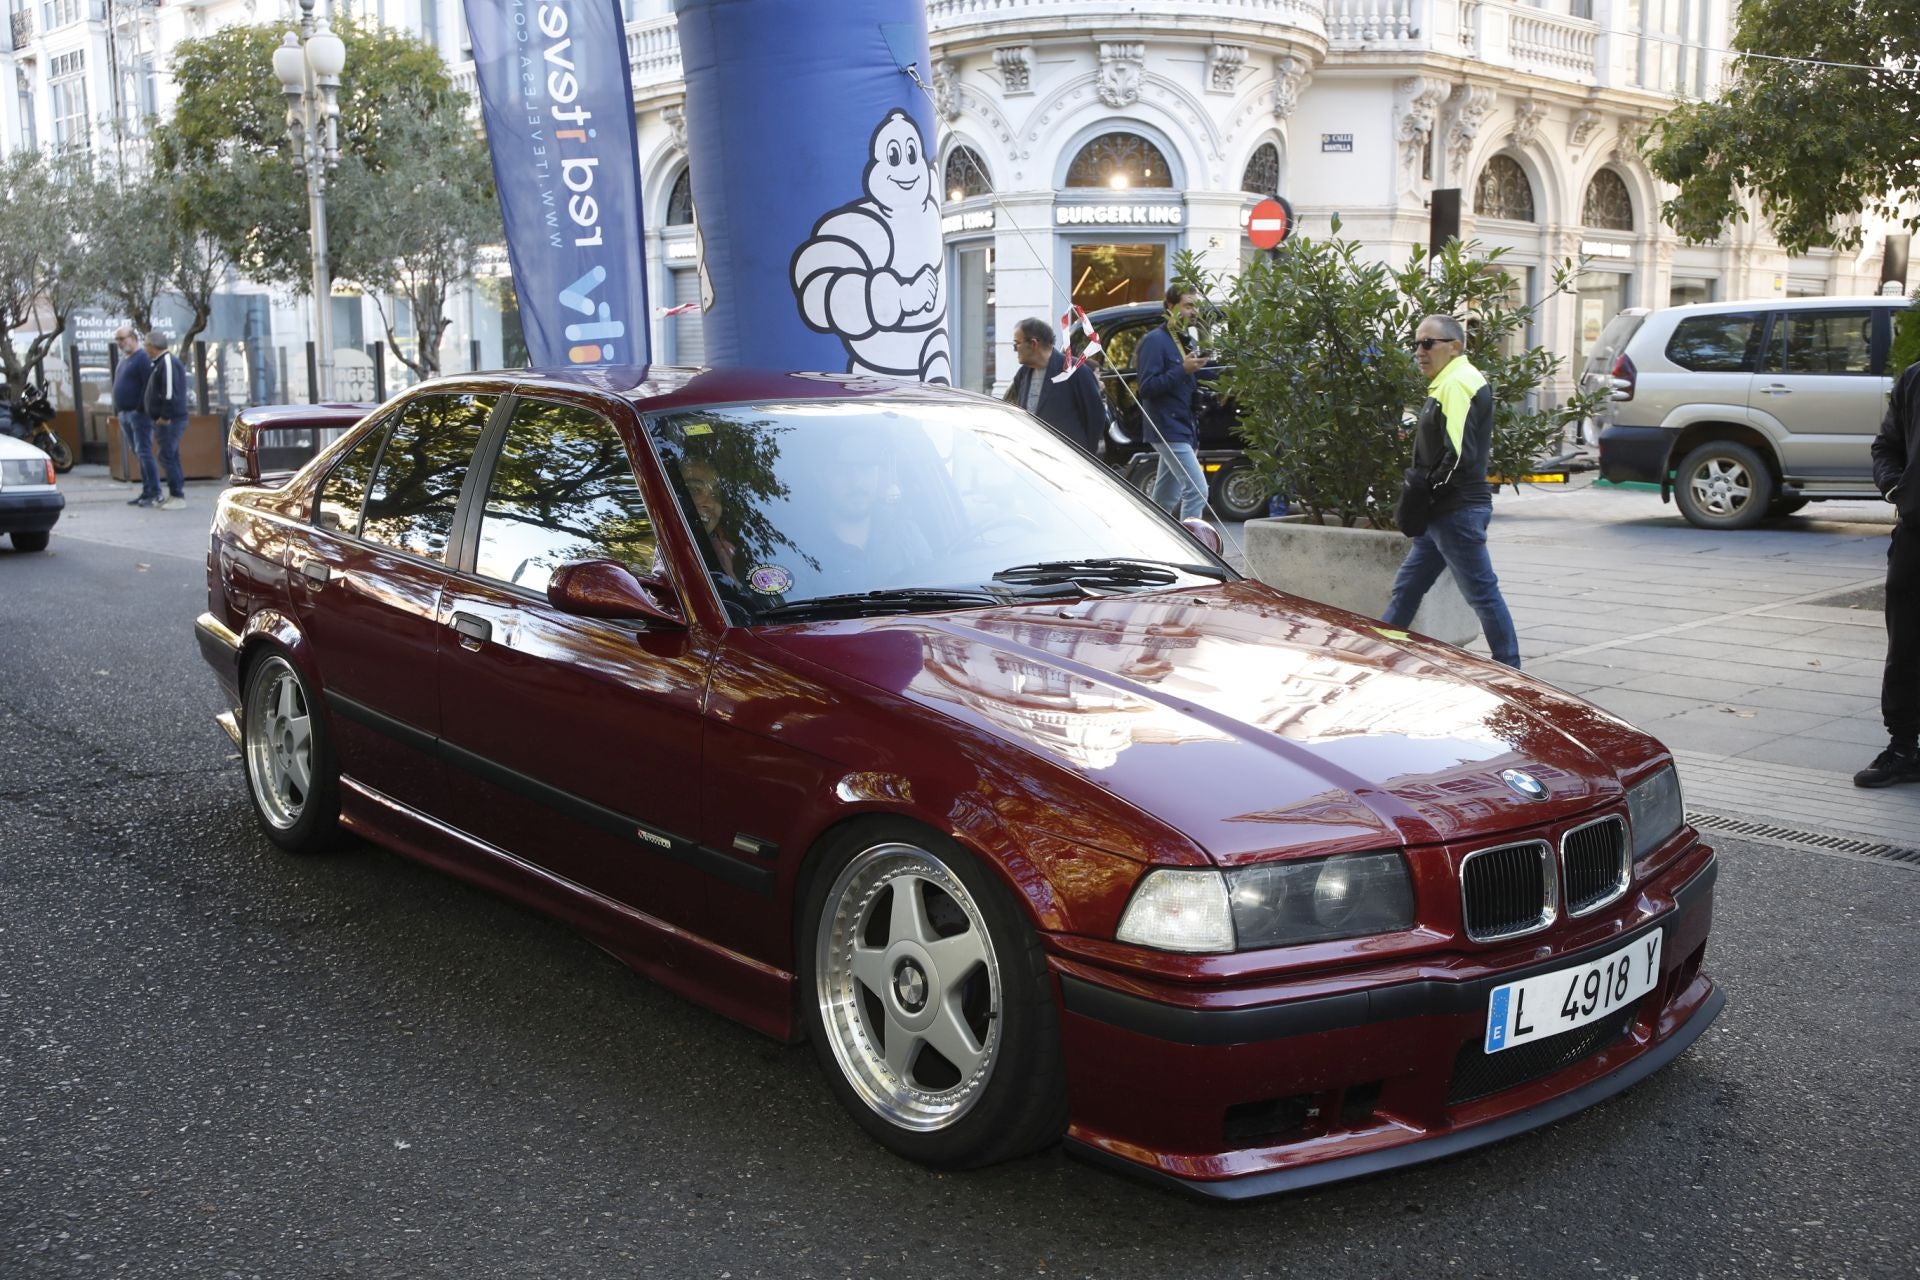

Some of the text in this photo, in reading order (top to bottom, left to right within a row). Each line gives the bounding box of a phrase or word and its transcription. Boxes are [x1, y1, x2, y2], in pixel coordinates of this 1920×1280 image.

[1056, 206, 1133, 225] BURGER
[74, 315, 104, 328] Todo
[105, 318, 119, 327] es
[335, 382, 376, 402] ING
[1514, 937, 1659, 1037] L 4918 Y
[1493, 1025, 1503, 1040] E
